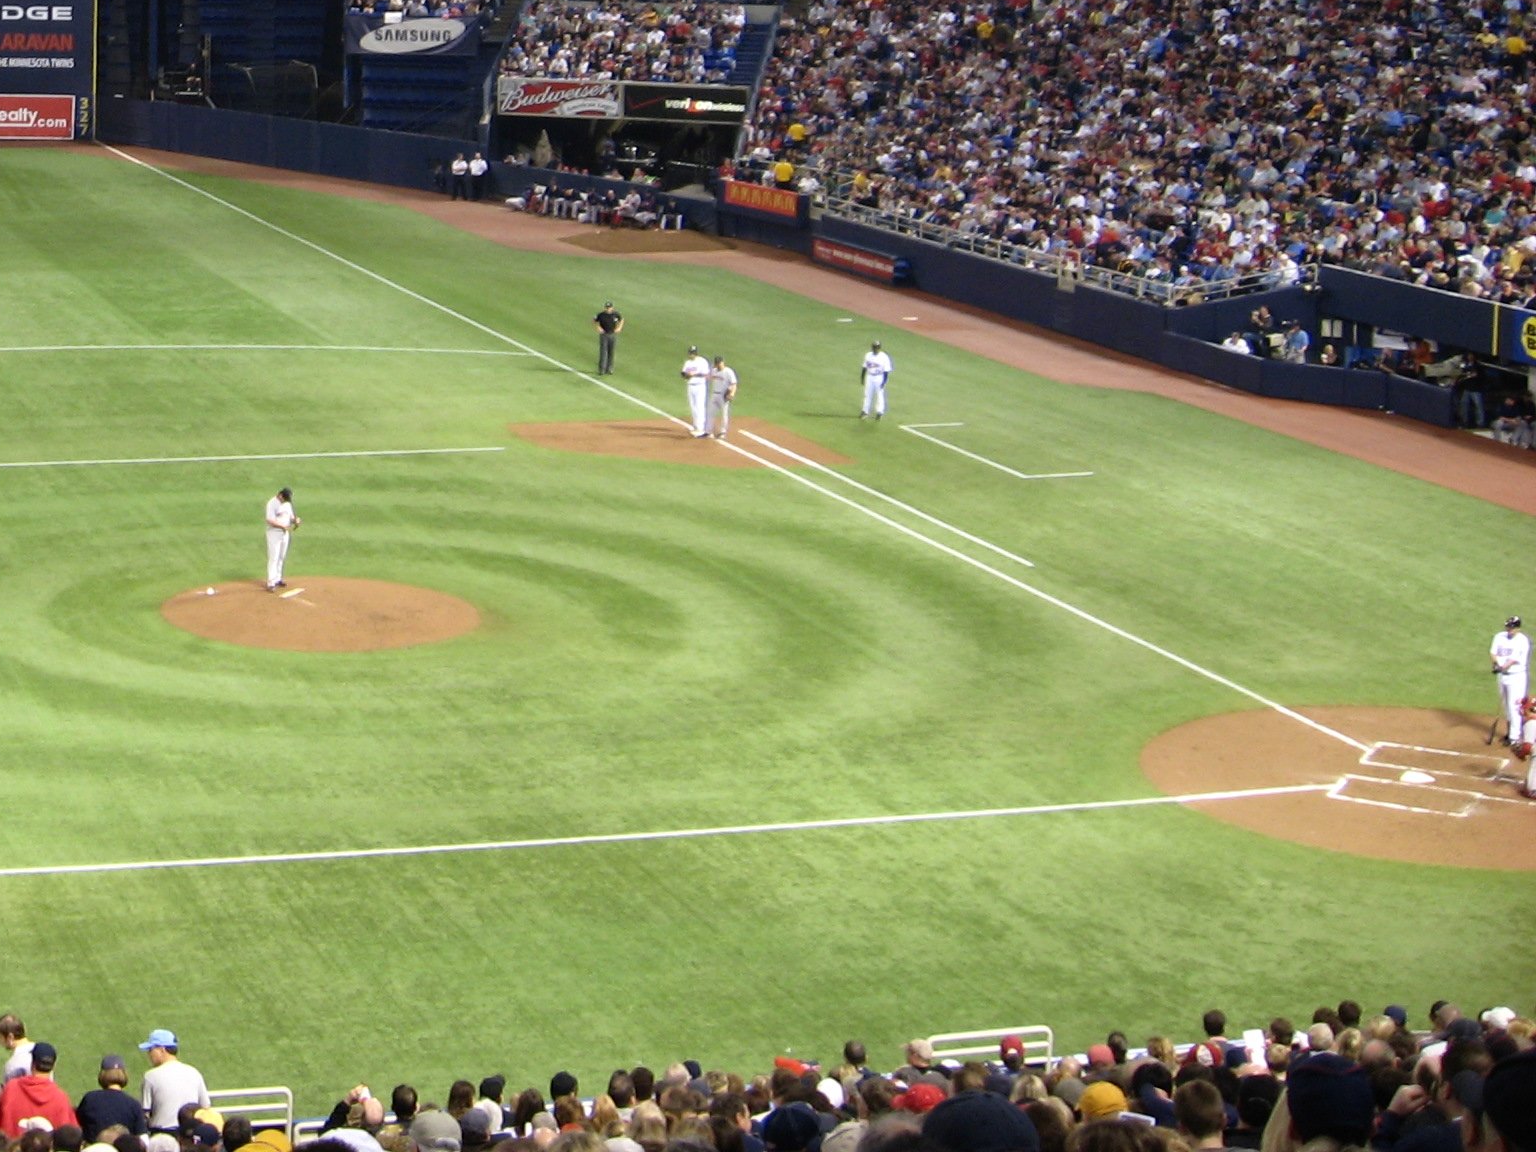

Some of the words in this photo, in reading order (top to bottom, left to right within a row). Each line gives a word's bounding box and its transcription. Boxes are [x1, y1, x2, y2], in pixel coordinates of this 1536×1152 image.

[375, 29, 451, 42] SAMSUNG
[9, 58, 50, 68] MINNESOTA
[501, 82, 612, 111] Budweiser
[665, 98, 712, 113] verizon
